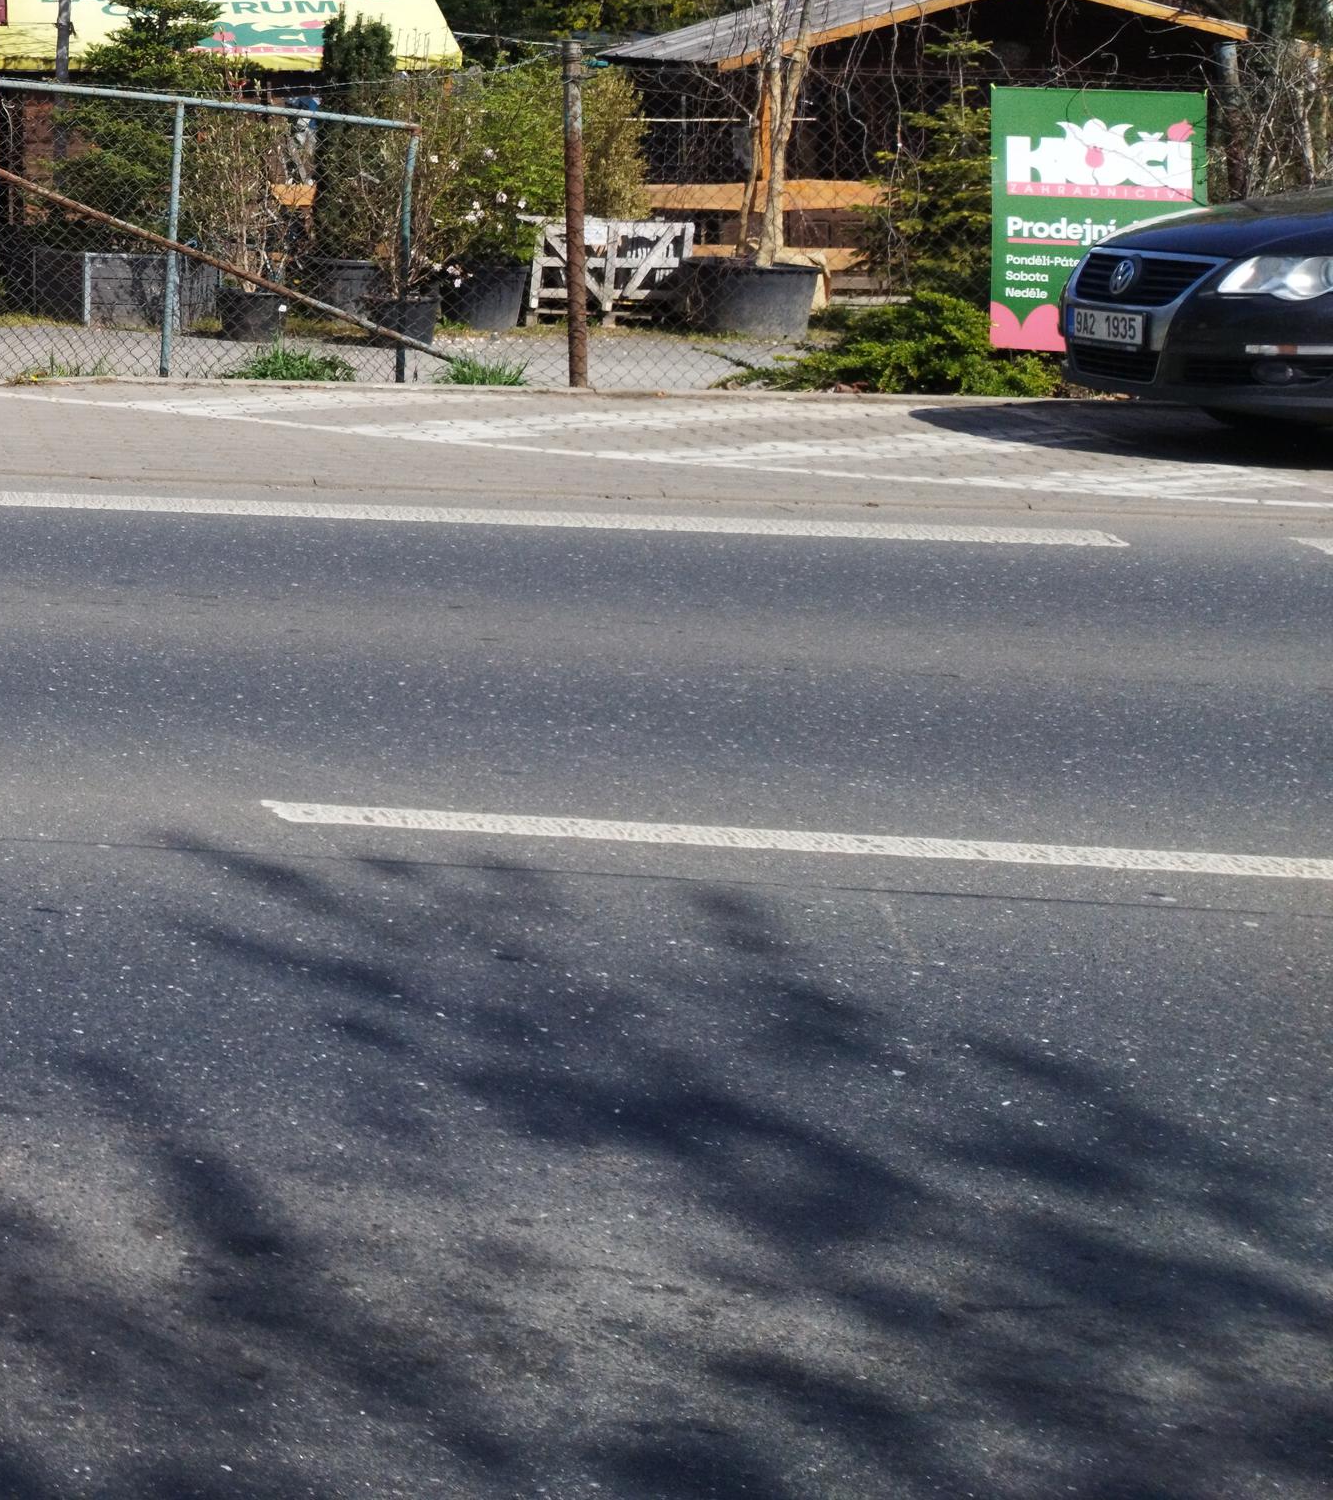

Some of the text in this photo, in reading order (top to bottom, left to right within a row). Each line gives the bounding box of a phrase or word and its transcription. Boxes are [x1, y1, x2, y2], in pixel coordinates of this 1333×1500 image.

[1005, 254, 1081, 268] Pondělí-Páte
[1005, 270, 1049, 283] Sobota
[1005, 286, 1048, 299] Neděle
[1076, 311, 1137, 341] 9A2 1935
